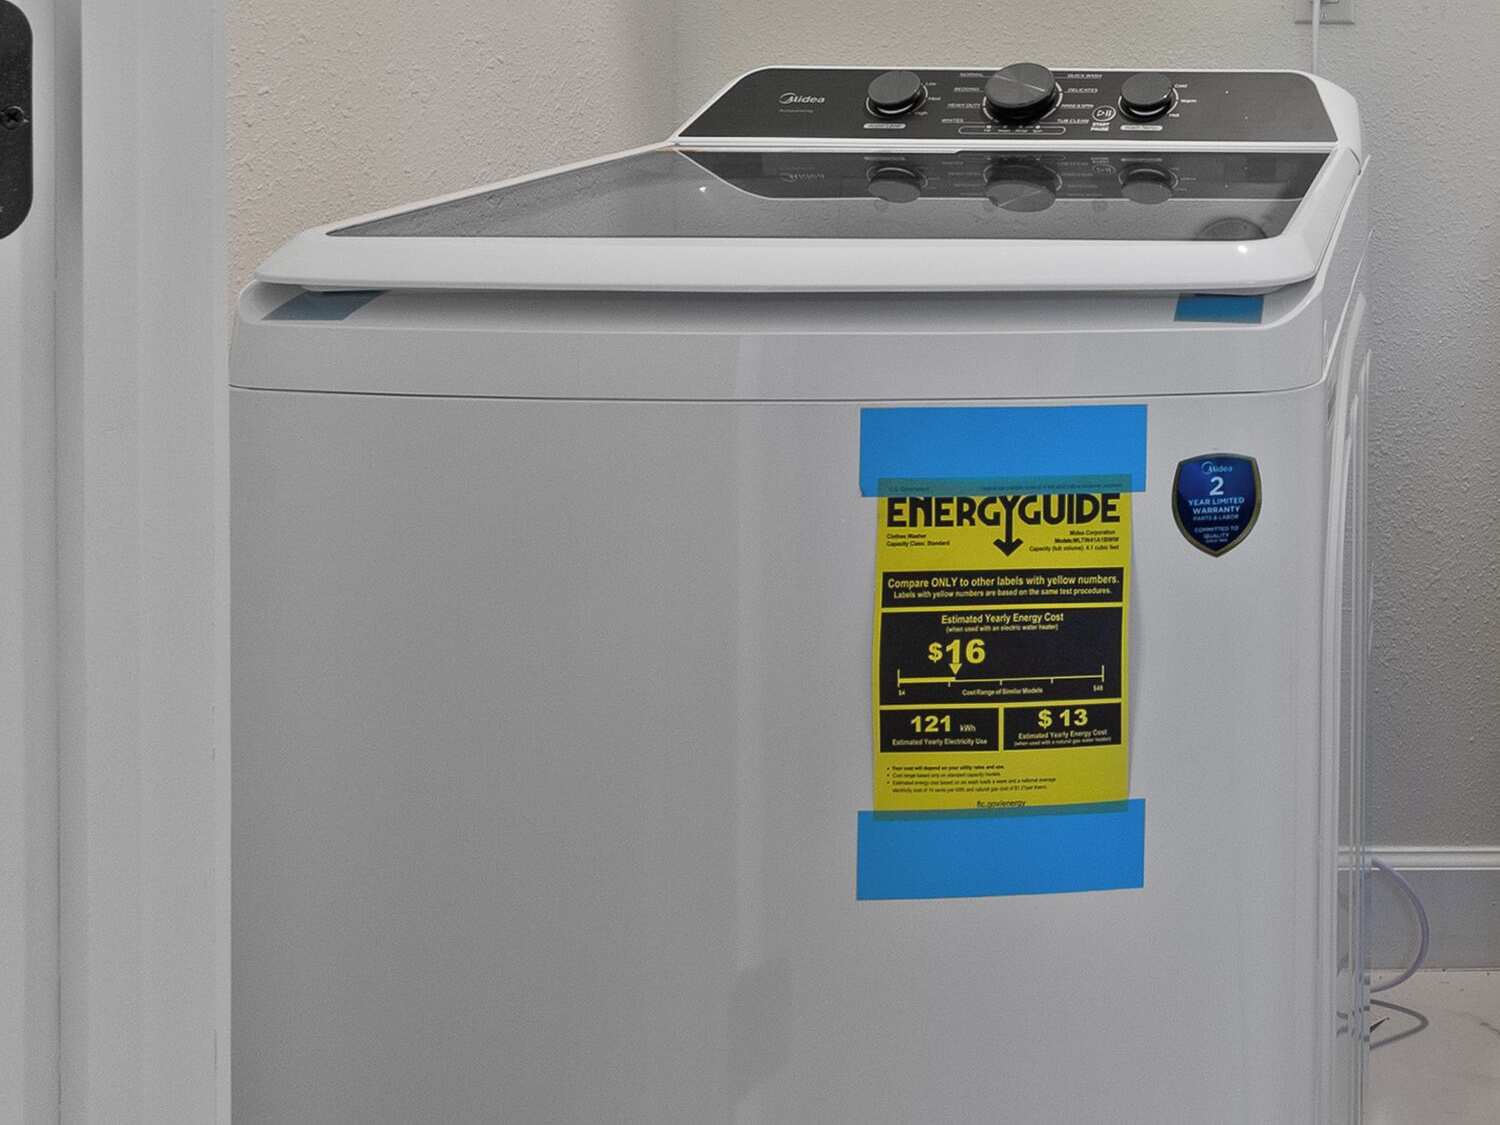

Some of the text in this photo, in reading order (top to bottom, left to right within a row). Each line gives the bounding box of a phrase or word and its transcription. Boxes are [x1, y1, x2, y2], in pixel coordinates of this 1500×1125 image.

[779, 93, 825, 104] Midea
[1201, 461, 1233, 475] Midea
[1209, 476, 1224, 496] 2
[1188, 497, 1245, 506] YEAR LIMITED
[887, 492, 1120, 527] ENERGYGUIDE
[1192, 506, 1240, 515] WARRANTY
[888, 575, 1119, 589] Compare ONLY to other labels with yellow numbers.
[893, 591, 915, 599] Labels
[933, 590, 954, 599] yellow
[998, 588, 1017, 596] based
[941, 612, 1064, 624] Estimated Yearly Energy Cost
[928, 639, 986, 664] $16
[911, 715, 976, 732] 121 kWh
[1018, 732, 1048, 740] Estimated
[1049, 731, 1069, 739] Yearly
[1070, 730, 1091, 738] Energy
[924, 738, 943, 746] Yearly
[944, 738, 974, 746] Electricity
